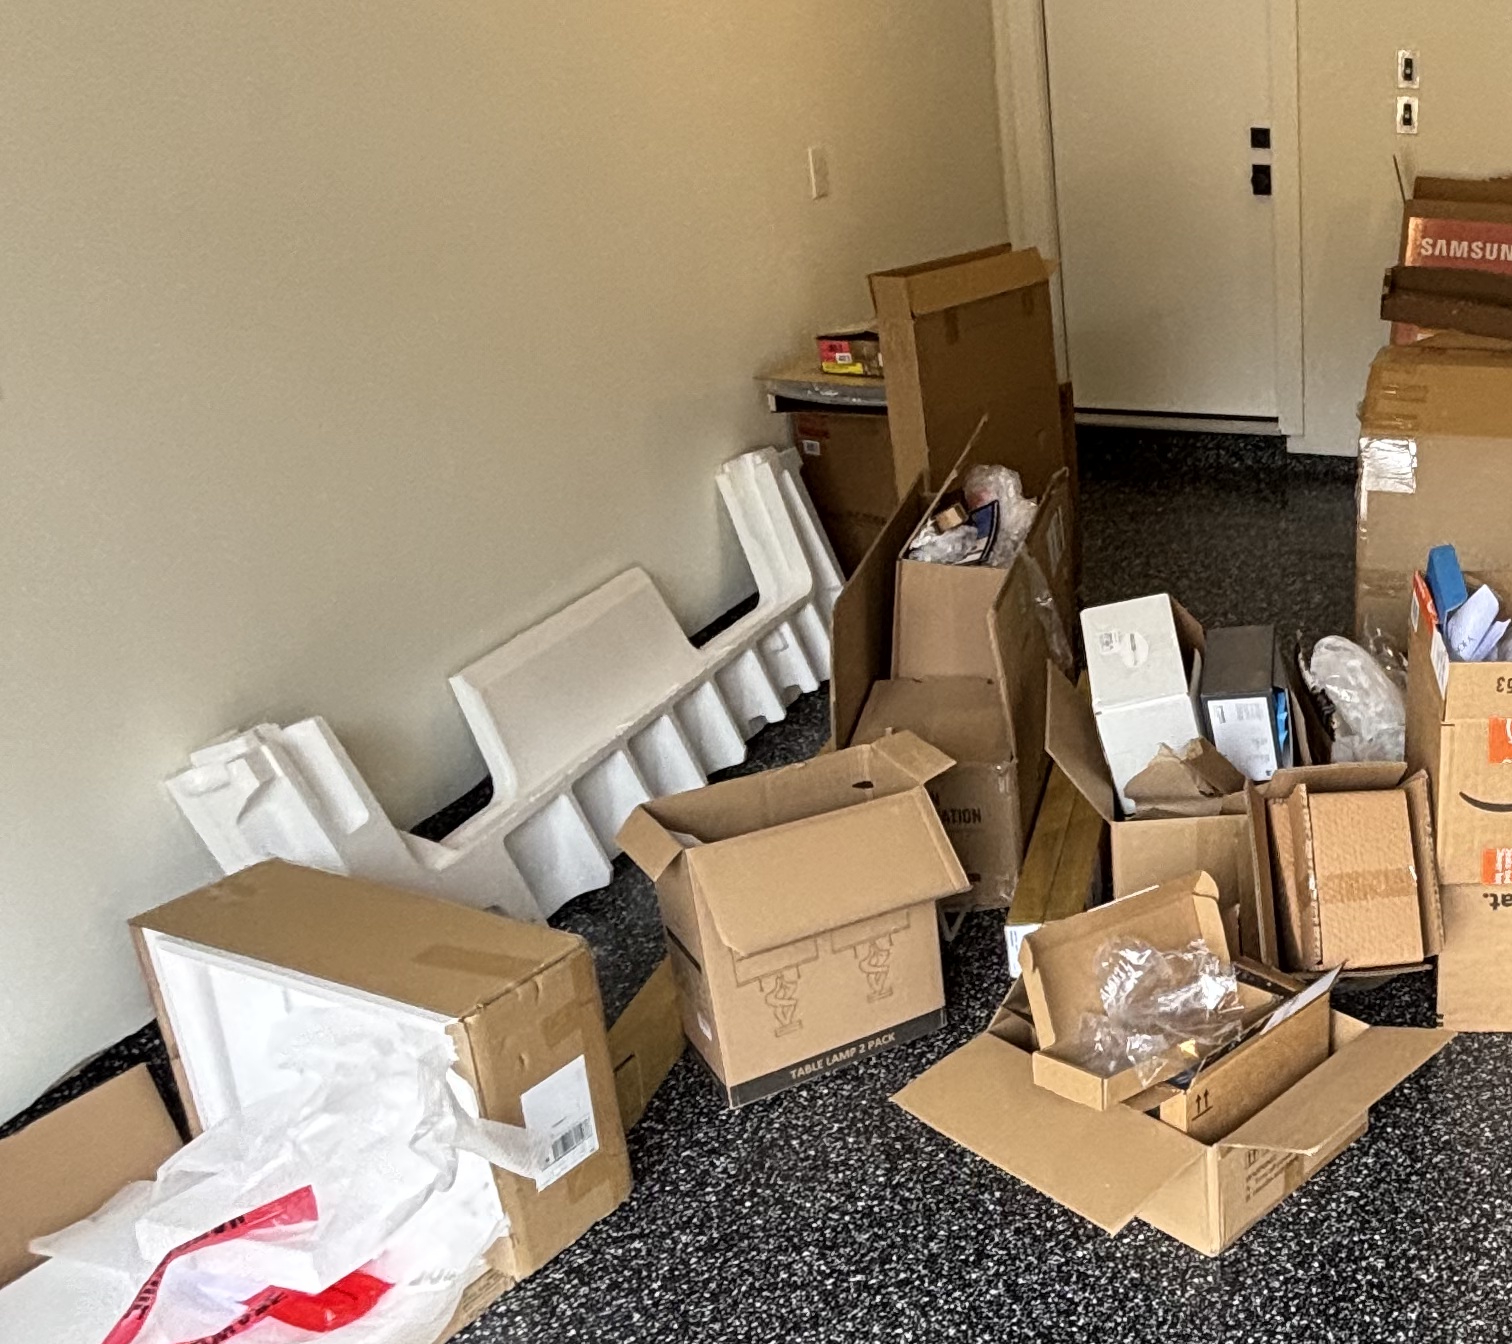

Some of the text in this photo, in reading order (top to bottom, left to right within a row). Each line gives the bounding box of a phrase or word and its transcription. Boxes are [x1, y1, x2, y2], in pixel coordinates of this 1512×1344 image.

[938, 808, 982, 825] ATION
[790, 1032, 896, 1079] TABLE LAMP 2 PACK
